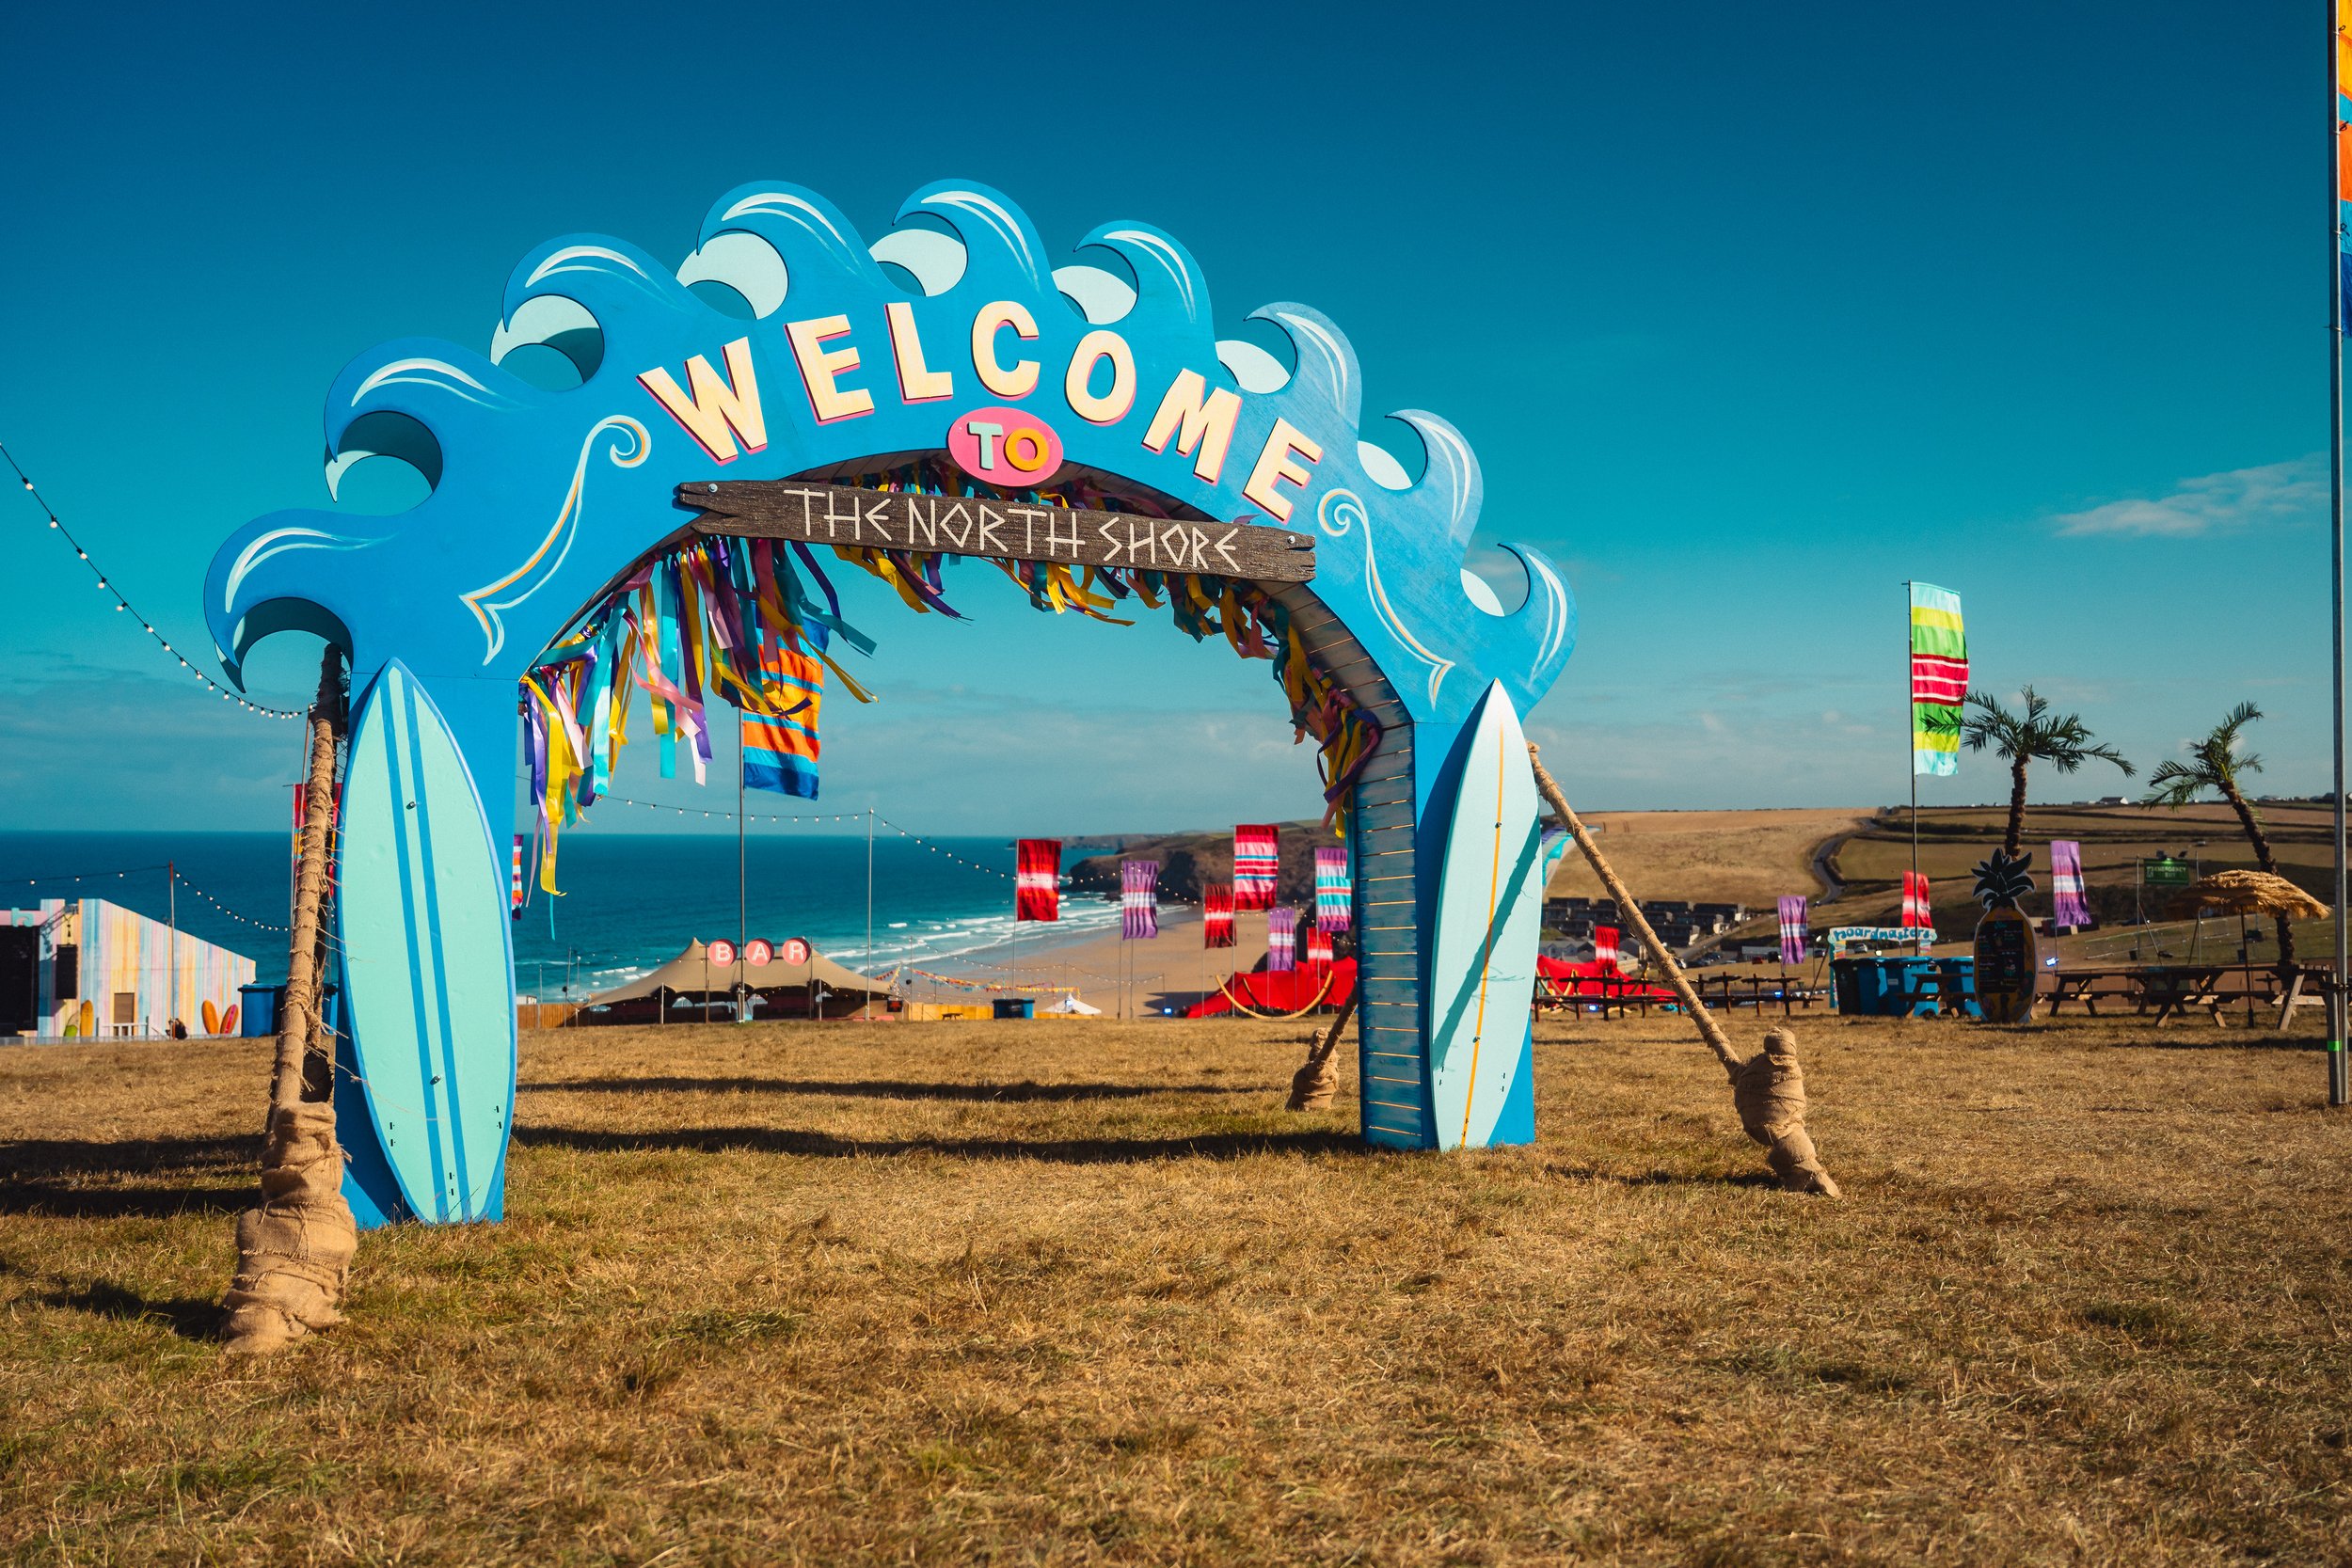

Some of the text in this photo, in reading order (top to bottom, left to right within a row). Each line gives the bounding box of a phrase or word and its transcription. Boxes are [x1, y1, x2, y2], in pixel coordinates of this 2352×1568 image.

[636, 301, 1324, 525] WELCOME
[966, 421, 1050, 472] TO
[783, 488, 1241, 572] THE NORTH SHORE
[715, 942, 805, 961] BAR
